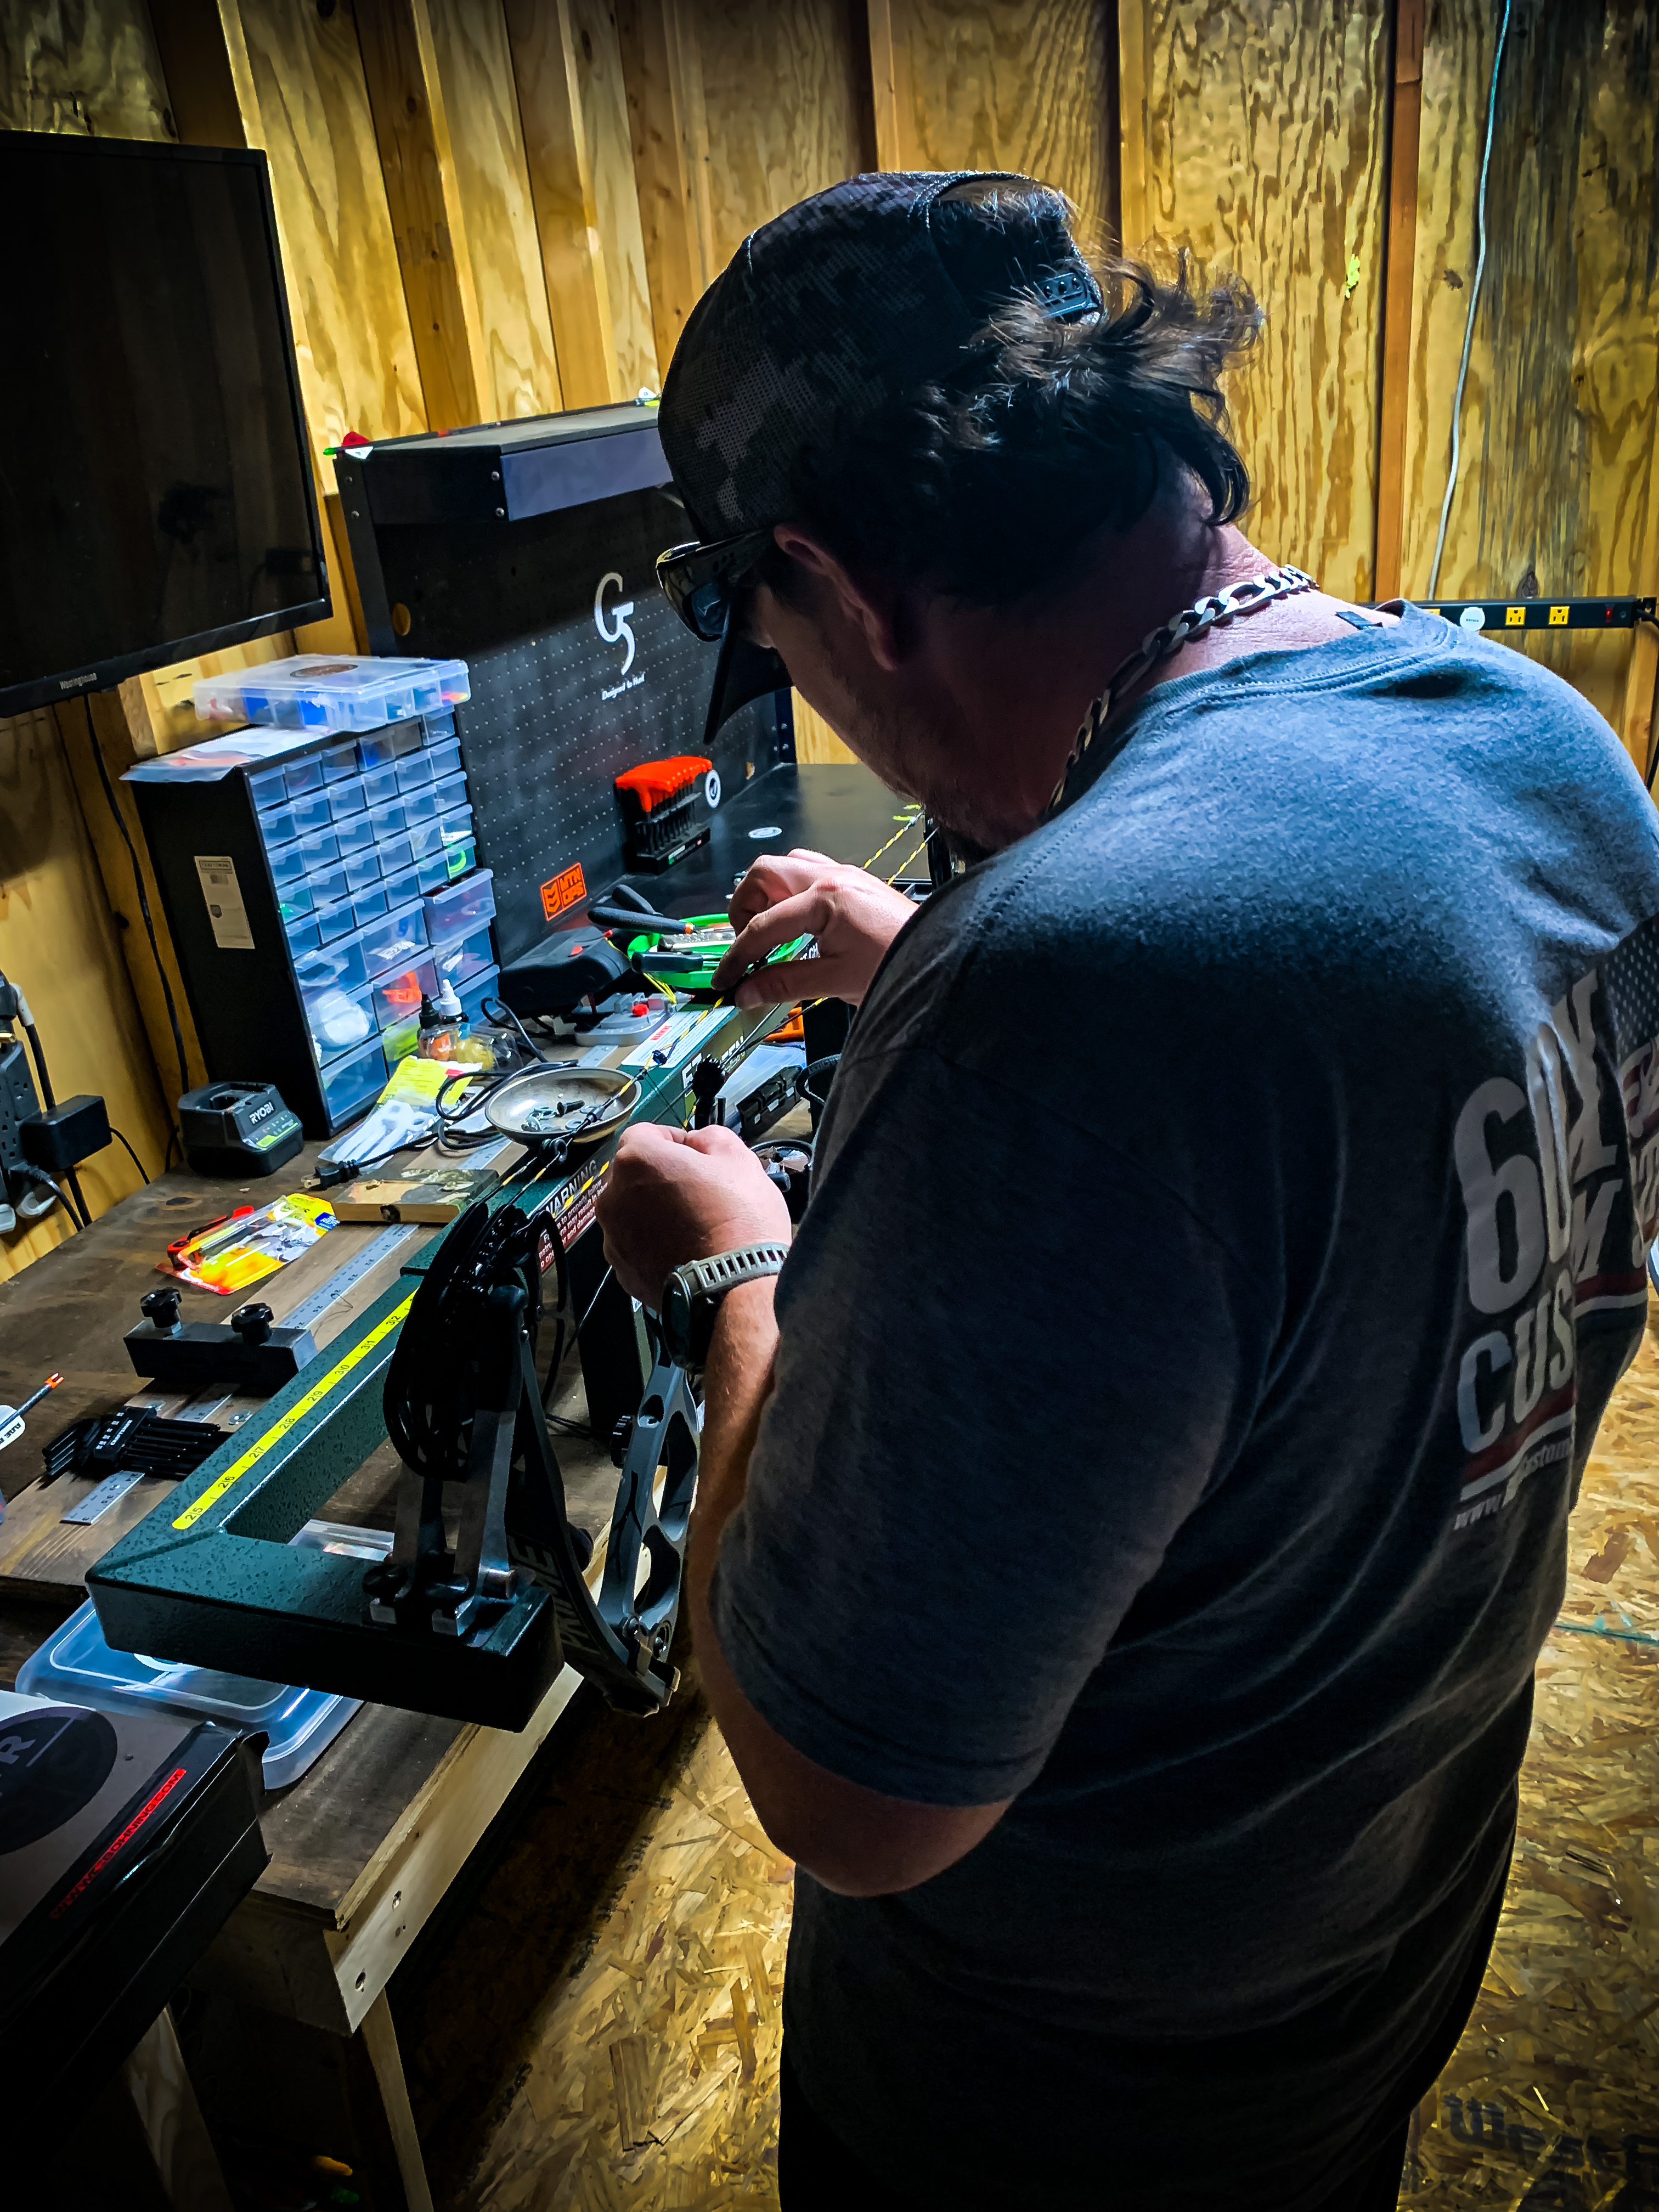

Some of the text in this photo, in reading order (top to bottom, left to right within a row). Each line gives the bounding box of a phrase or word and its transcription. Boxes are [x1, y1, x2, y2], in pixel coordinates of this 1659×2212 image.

[559, 867, 582, 891] MTN
[563, 882, 585, 904] OPS
[249, 1101, 274, 1125] RYOBI
[185, 1315, 402, 1521] 25 26 27 28 29 30 31 32
